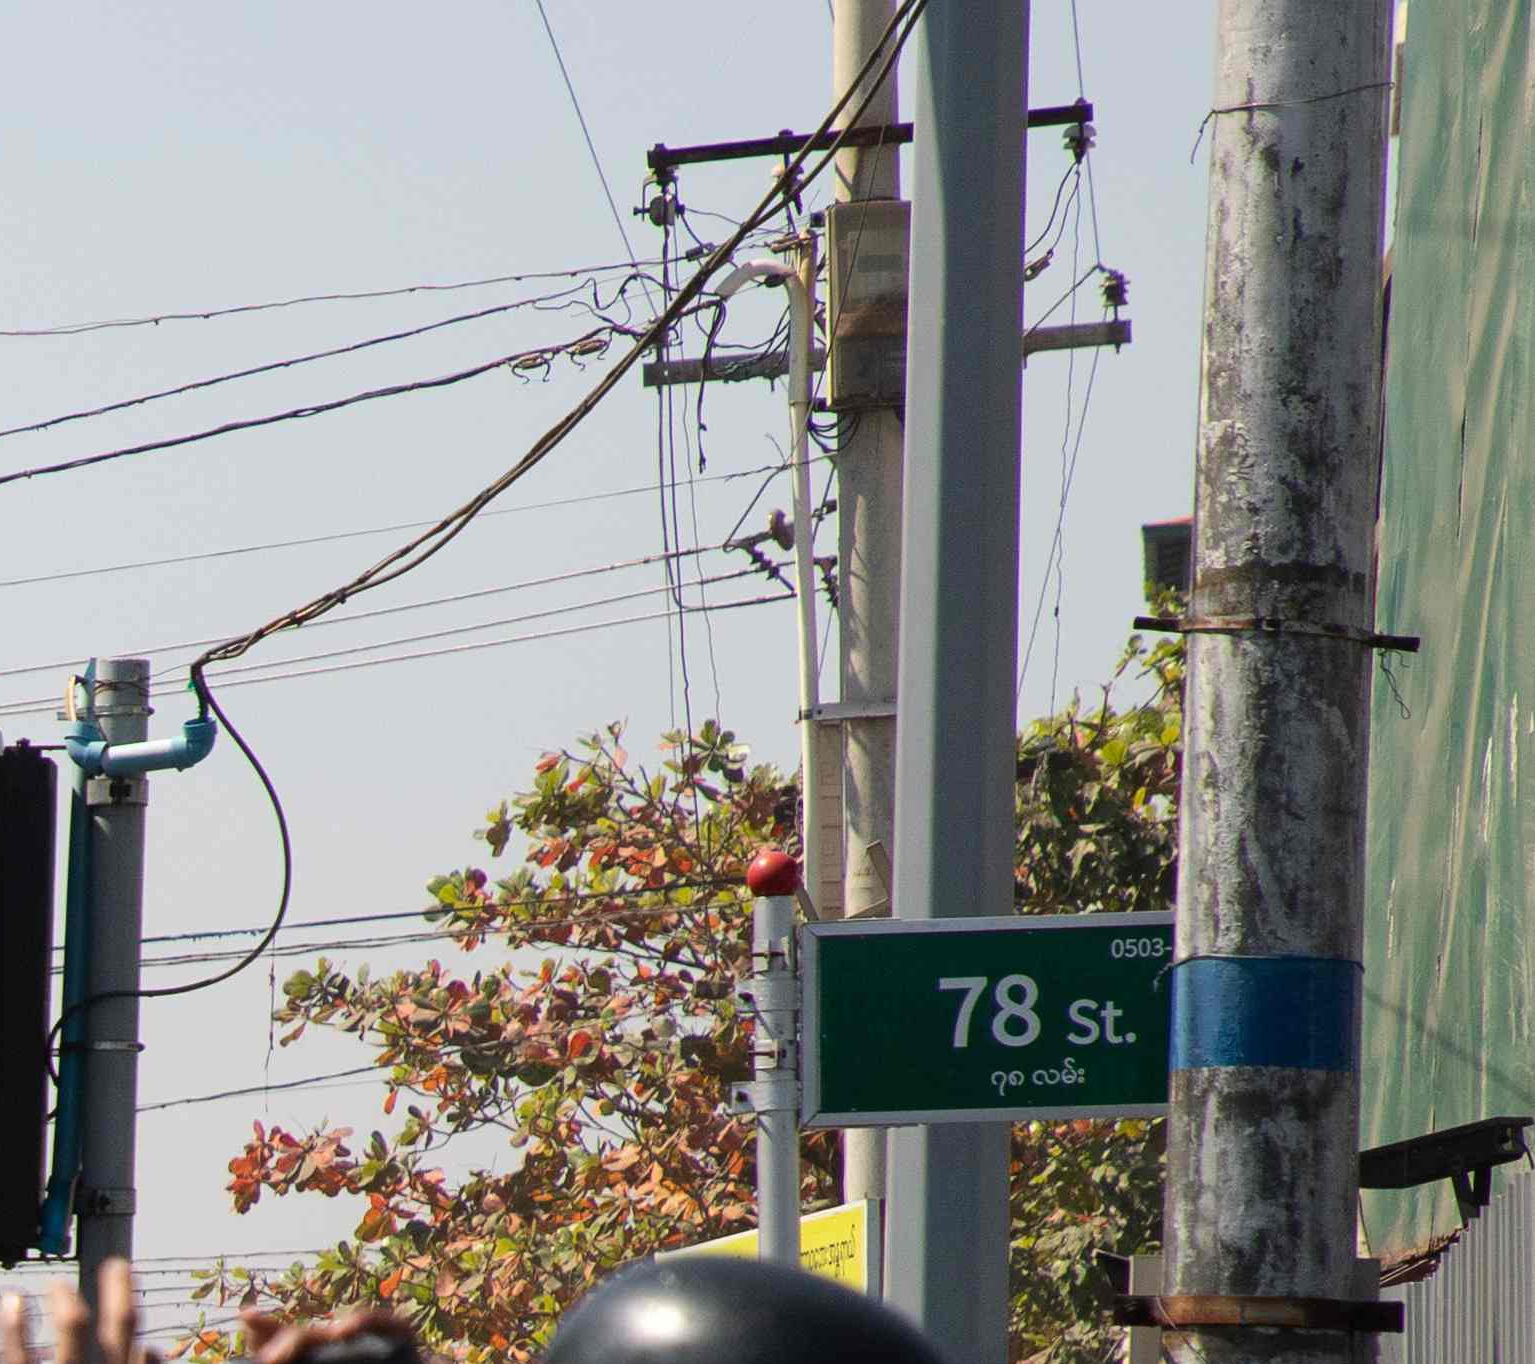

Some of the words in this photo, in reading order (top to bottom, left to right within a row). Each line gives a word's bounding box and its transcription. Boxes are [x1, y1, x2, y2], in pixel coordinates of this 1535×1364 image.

[938, 974, 1042, 1049] 78
[1066, 999, 1138, 1045] St.
[990, 1069, 1025, 1096] ၇၈
[1032, 1057, 1086, 1086] လမ်း
